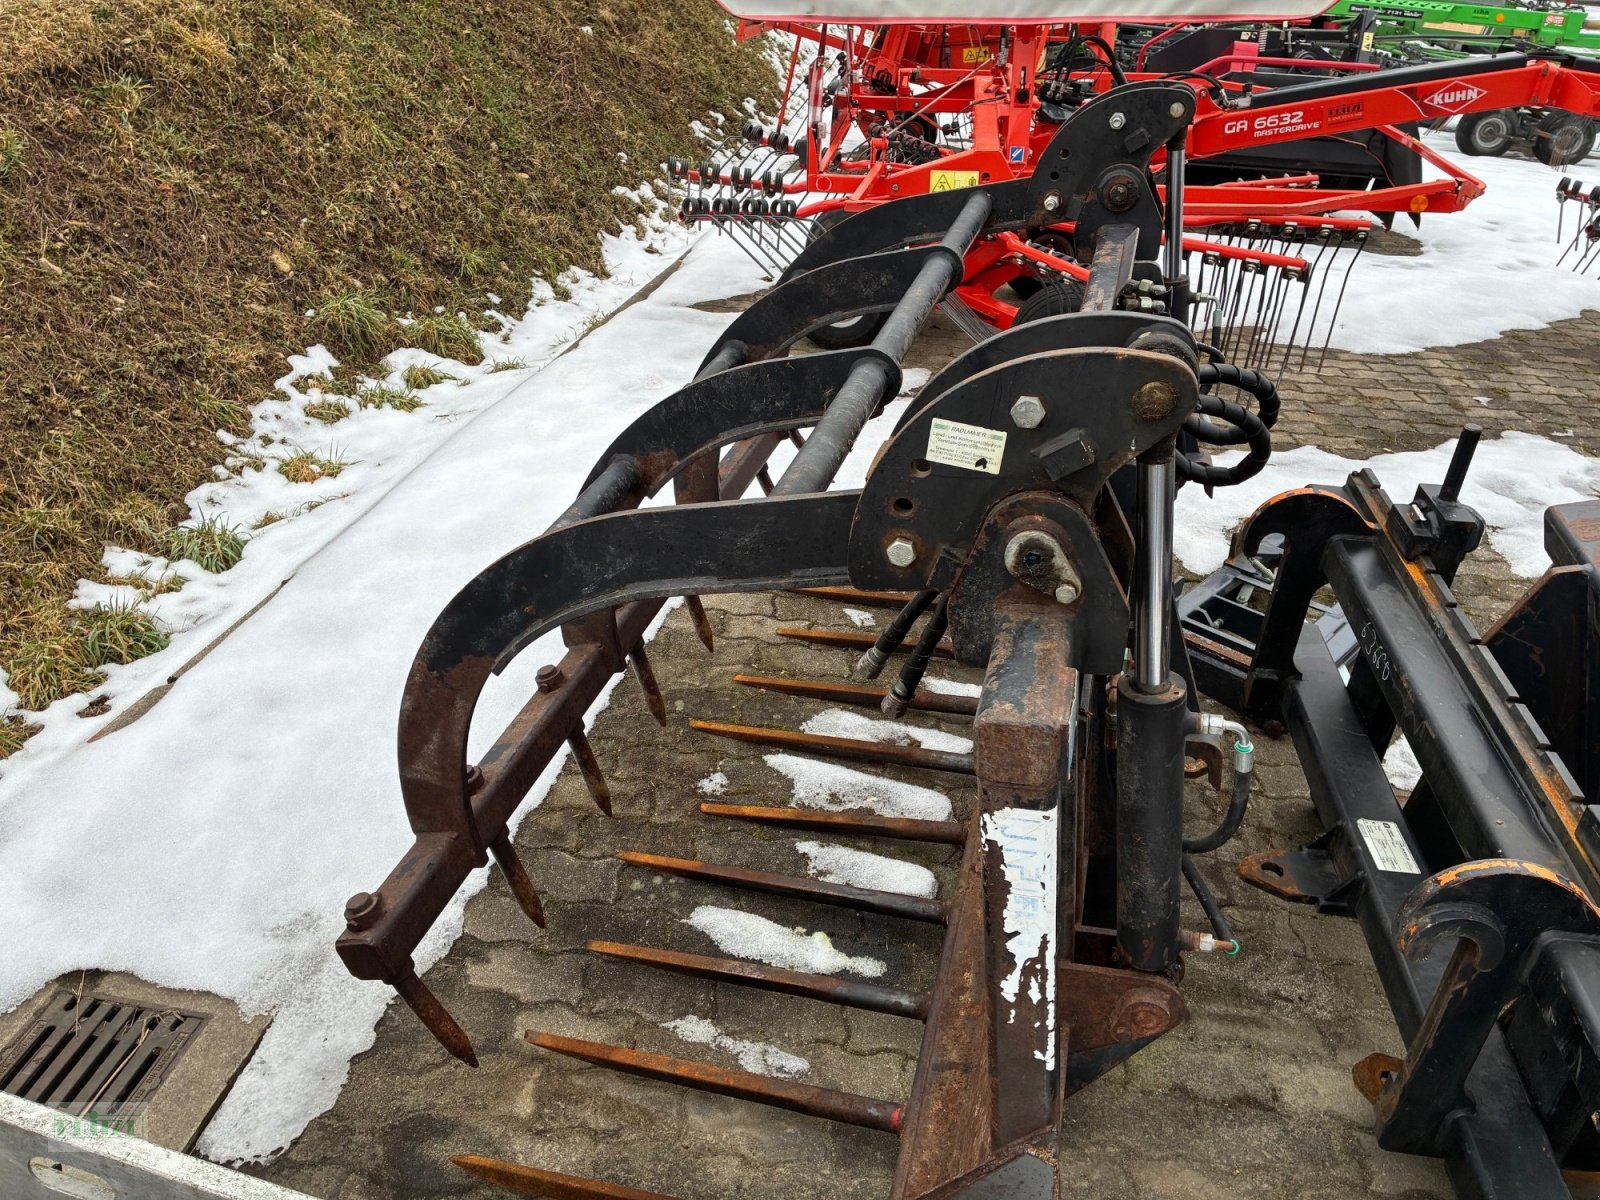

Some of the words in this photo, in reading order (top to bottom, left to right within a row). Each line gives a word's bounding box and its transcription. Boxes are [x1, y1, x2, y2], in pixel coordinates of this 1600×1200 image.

[1433, 88, 1478, 105] KUHN
[1224, 120, 1248, 134] GA
[1254, 111, 1304, 129] 6632
[1254, 122, 1320, 138] MASTERDRIVE
